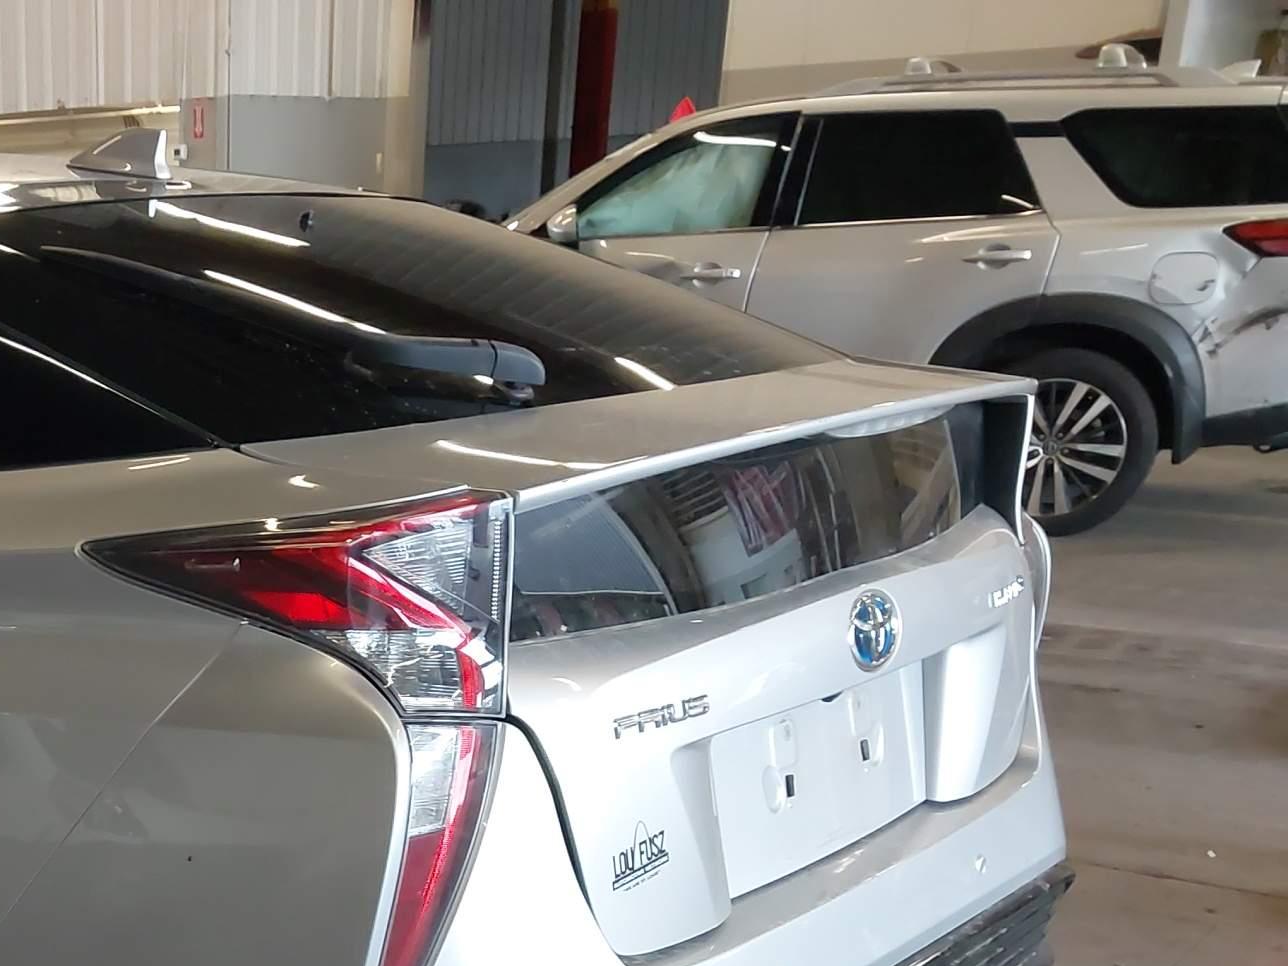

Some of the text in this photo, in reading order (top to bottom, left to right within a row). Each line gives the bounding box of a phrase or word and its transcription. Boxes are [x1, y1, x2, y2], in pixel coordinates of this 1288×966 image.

[613, 693, 710, 740] PRIUS
[613, 847, 634, 878] LOU
[638, 830, 666, 865] FUSZ
